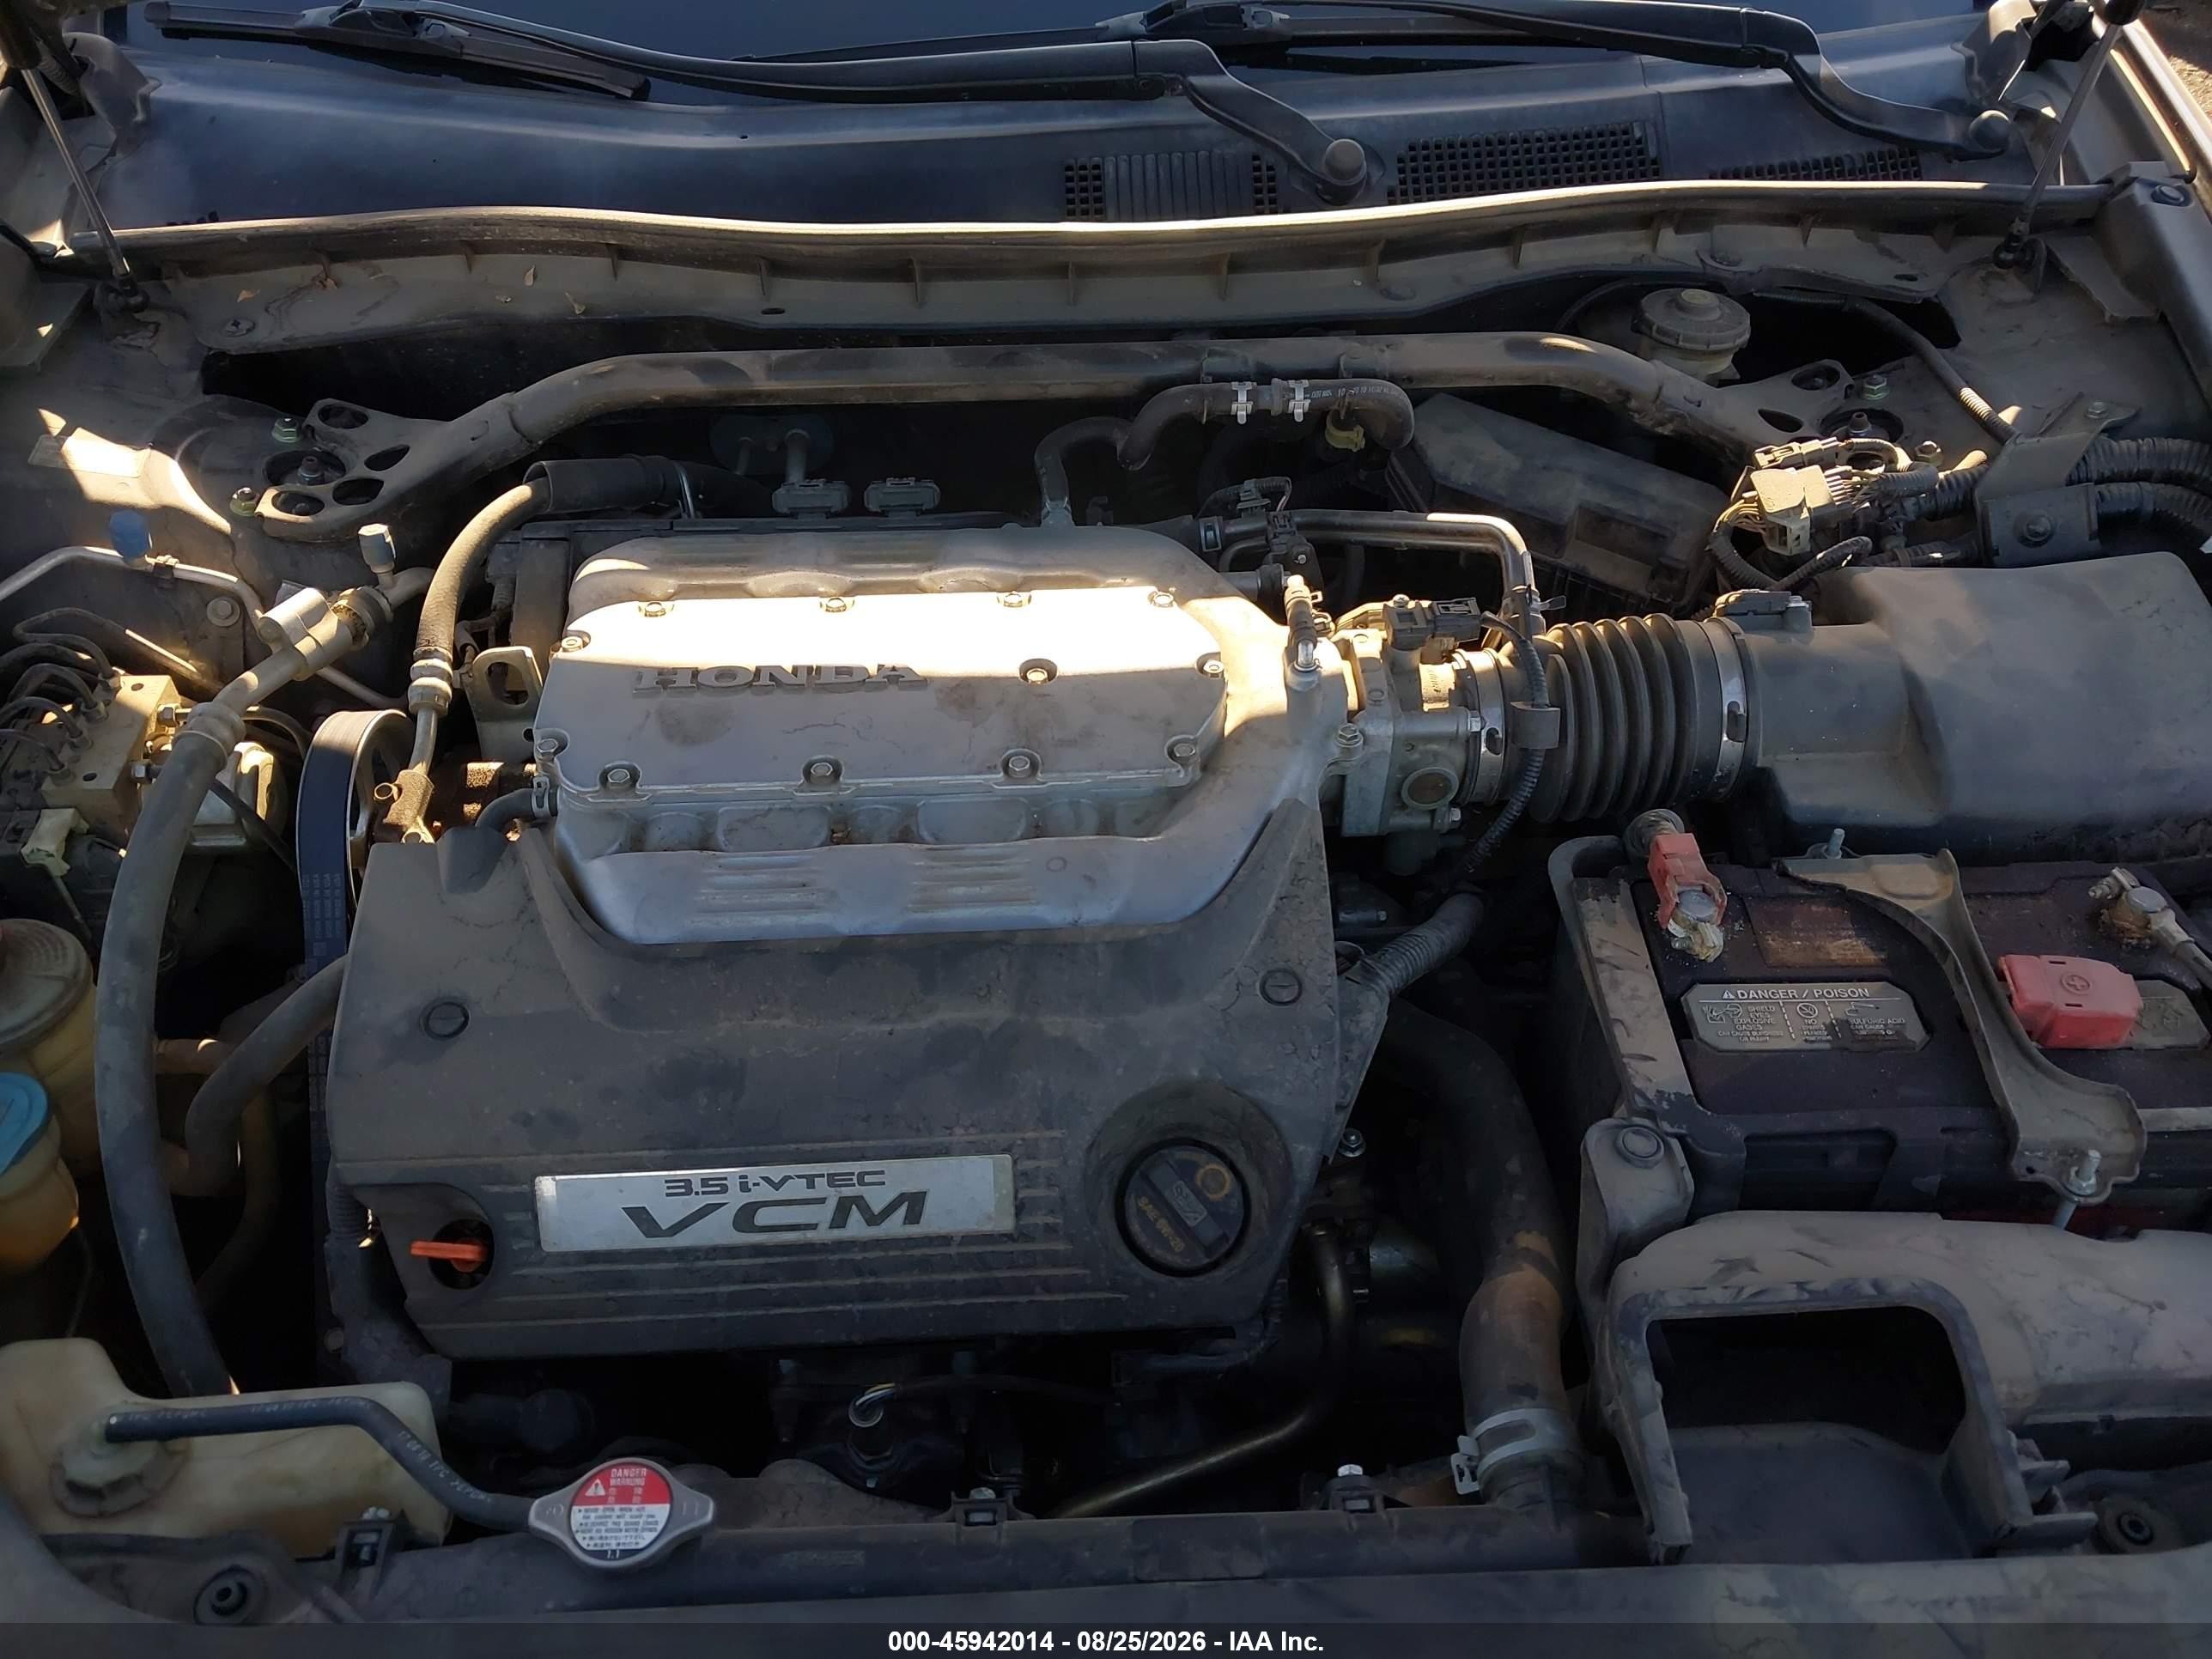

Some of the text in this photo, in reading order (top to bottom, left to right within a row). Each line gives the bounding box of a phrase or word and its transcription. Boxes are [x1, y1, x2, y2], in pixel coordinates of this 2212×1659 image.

[633, 664, 928, 694] HONDA
[1736, 988, 1870, 1000] DANGER / POISON
[665, 1170, 885, 1197] 3.5 i-VTEC
[621, 1191, 927, 1238] VCM
[611, 1468, 647, 1477] DANGER
